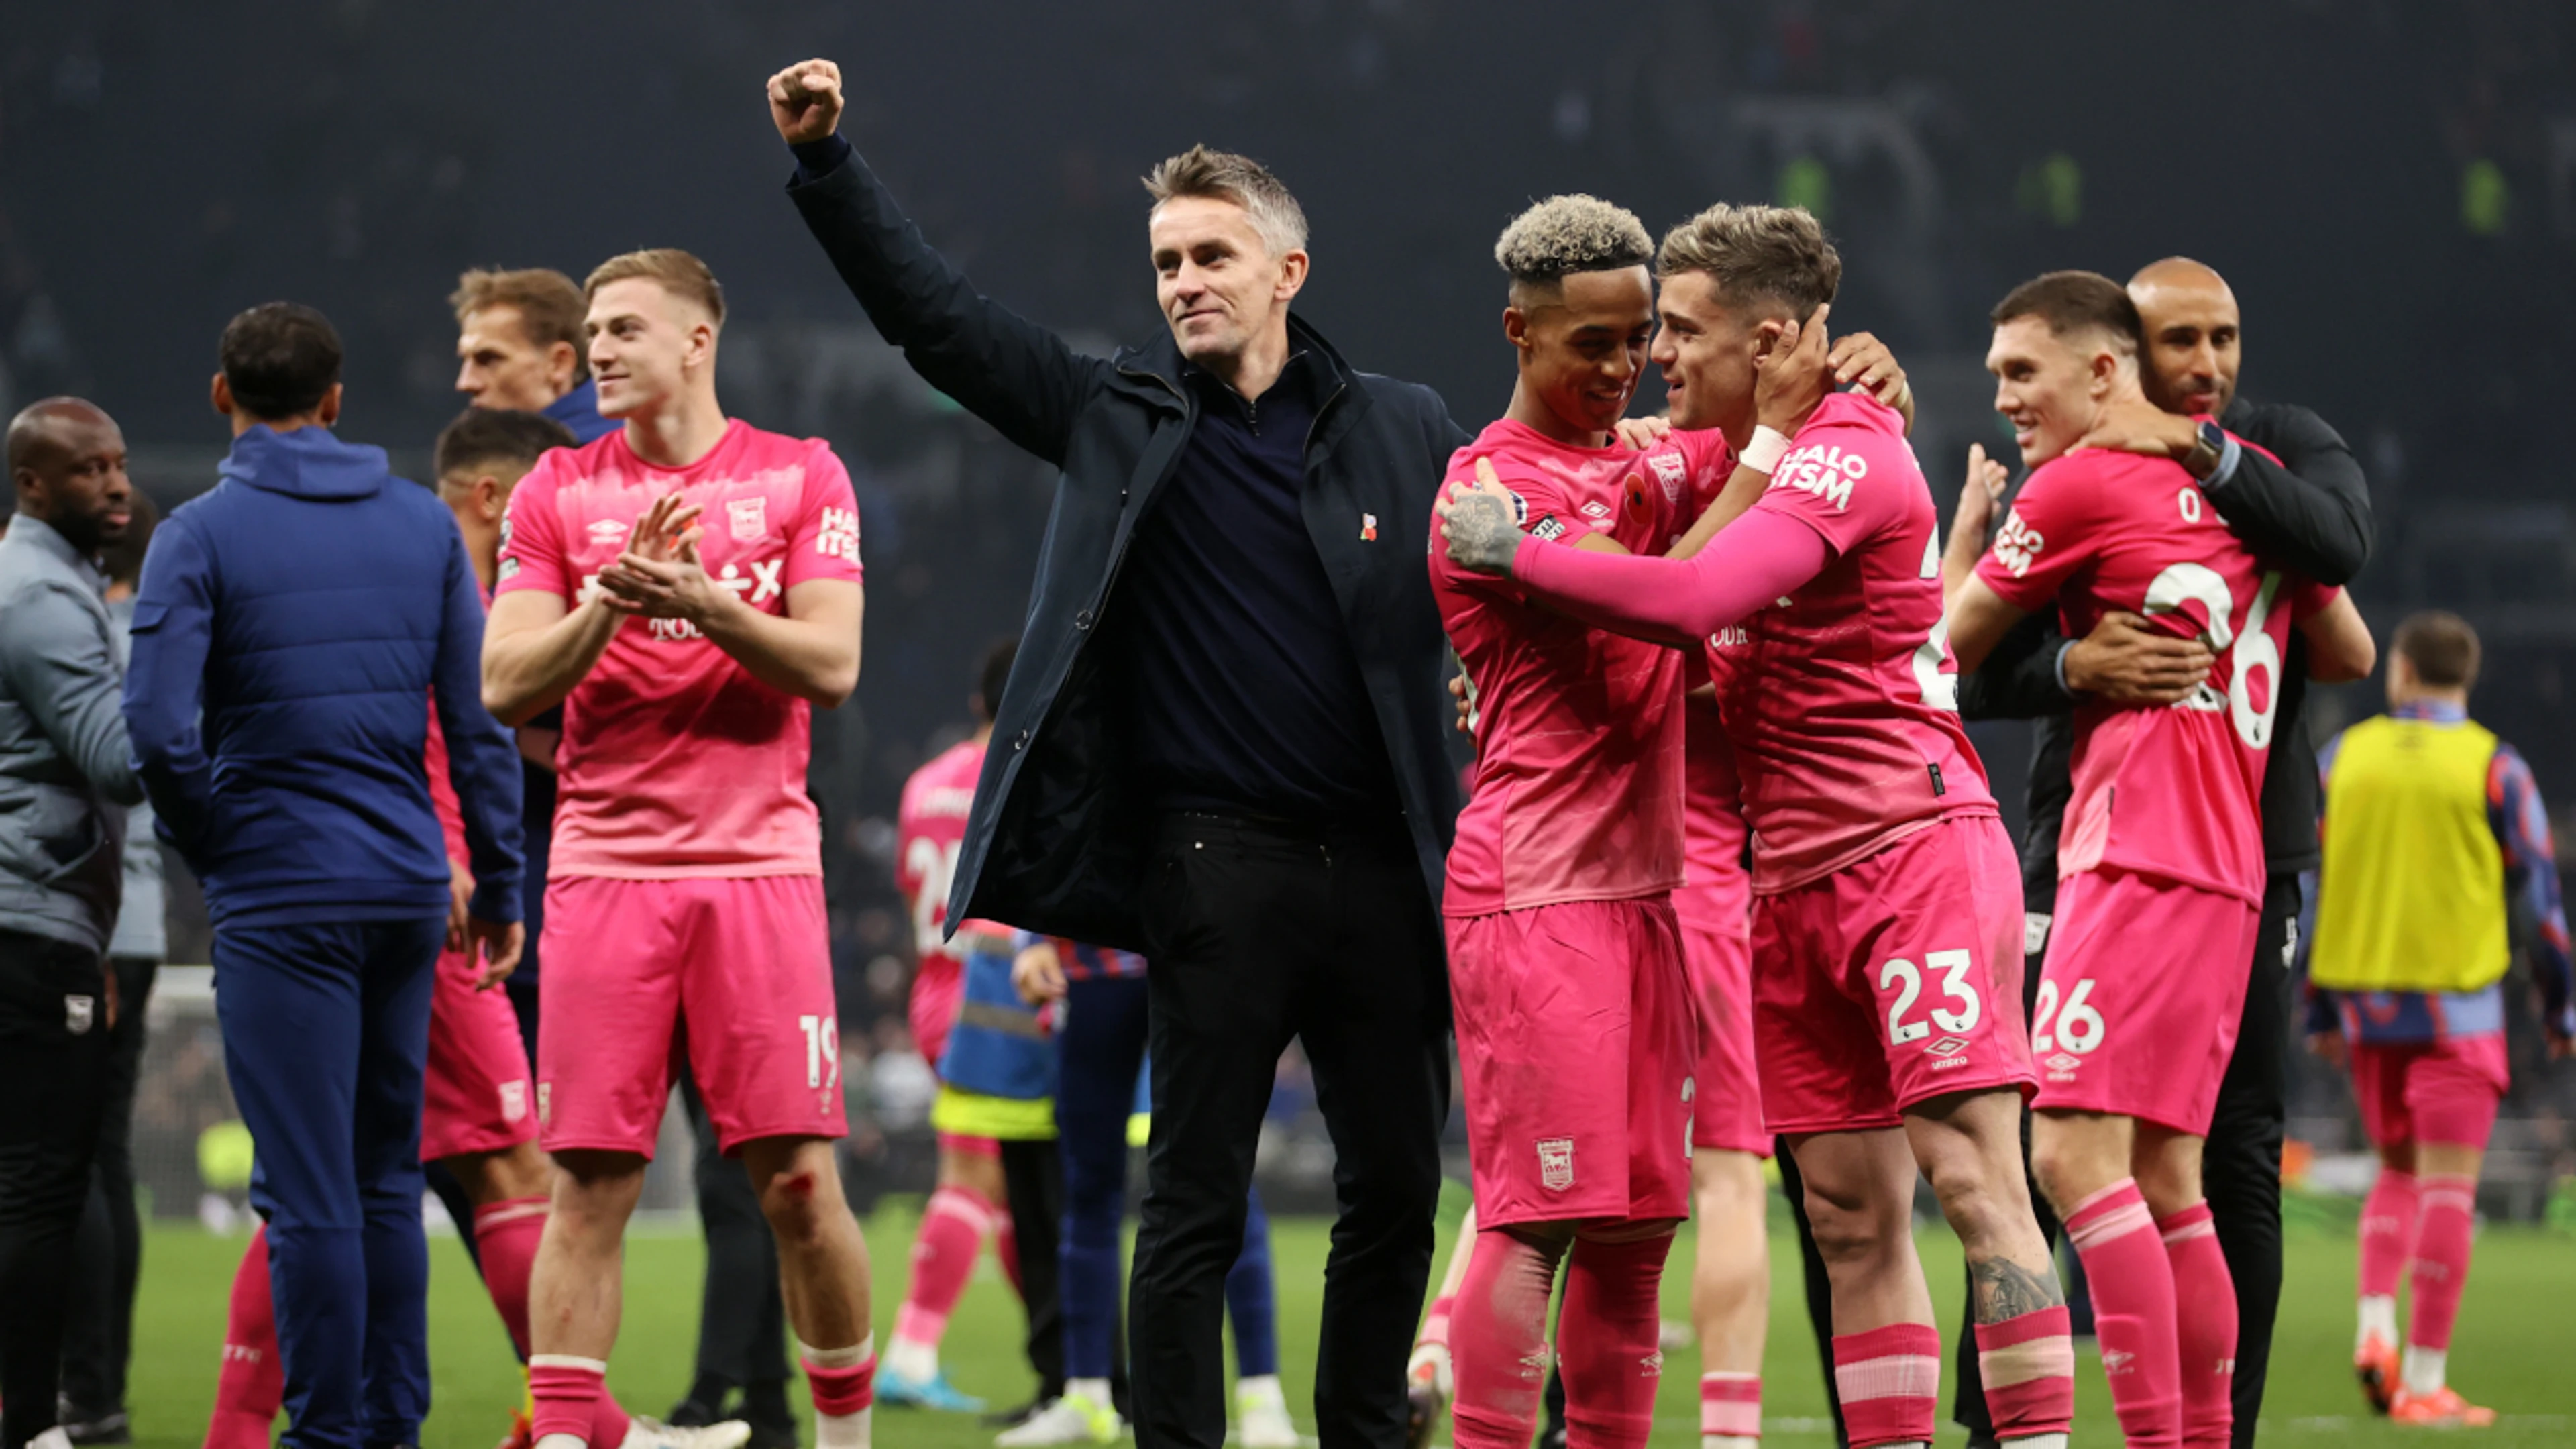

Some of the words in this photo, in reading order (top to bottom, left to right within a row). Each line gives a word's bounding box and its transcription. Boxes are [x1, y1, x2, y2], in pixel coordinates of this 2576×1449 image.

[1782, 444, 1868, 480] HALO
[1880, 948, 1981, 1046] 23
[2033, 978, 2105, 1054] 26
[799, 1014, 838, 1089] 19
